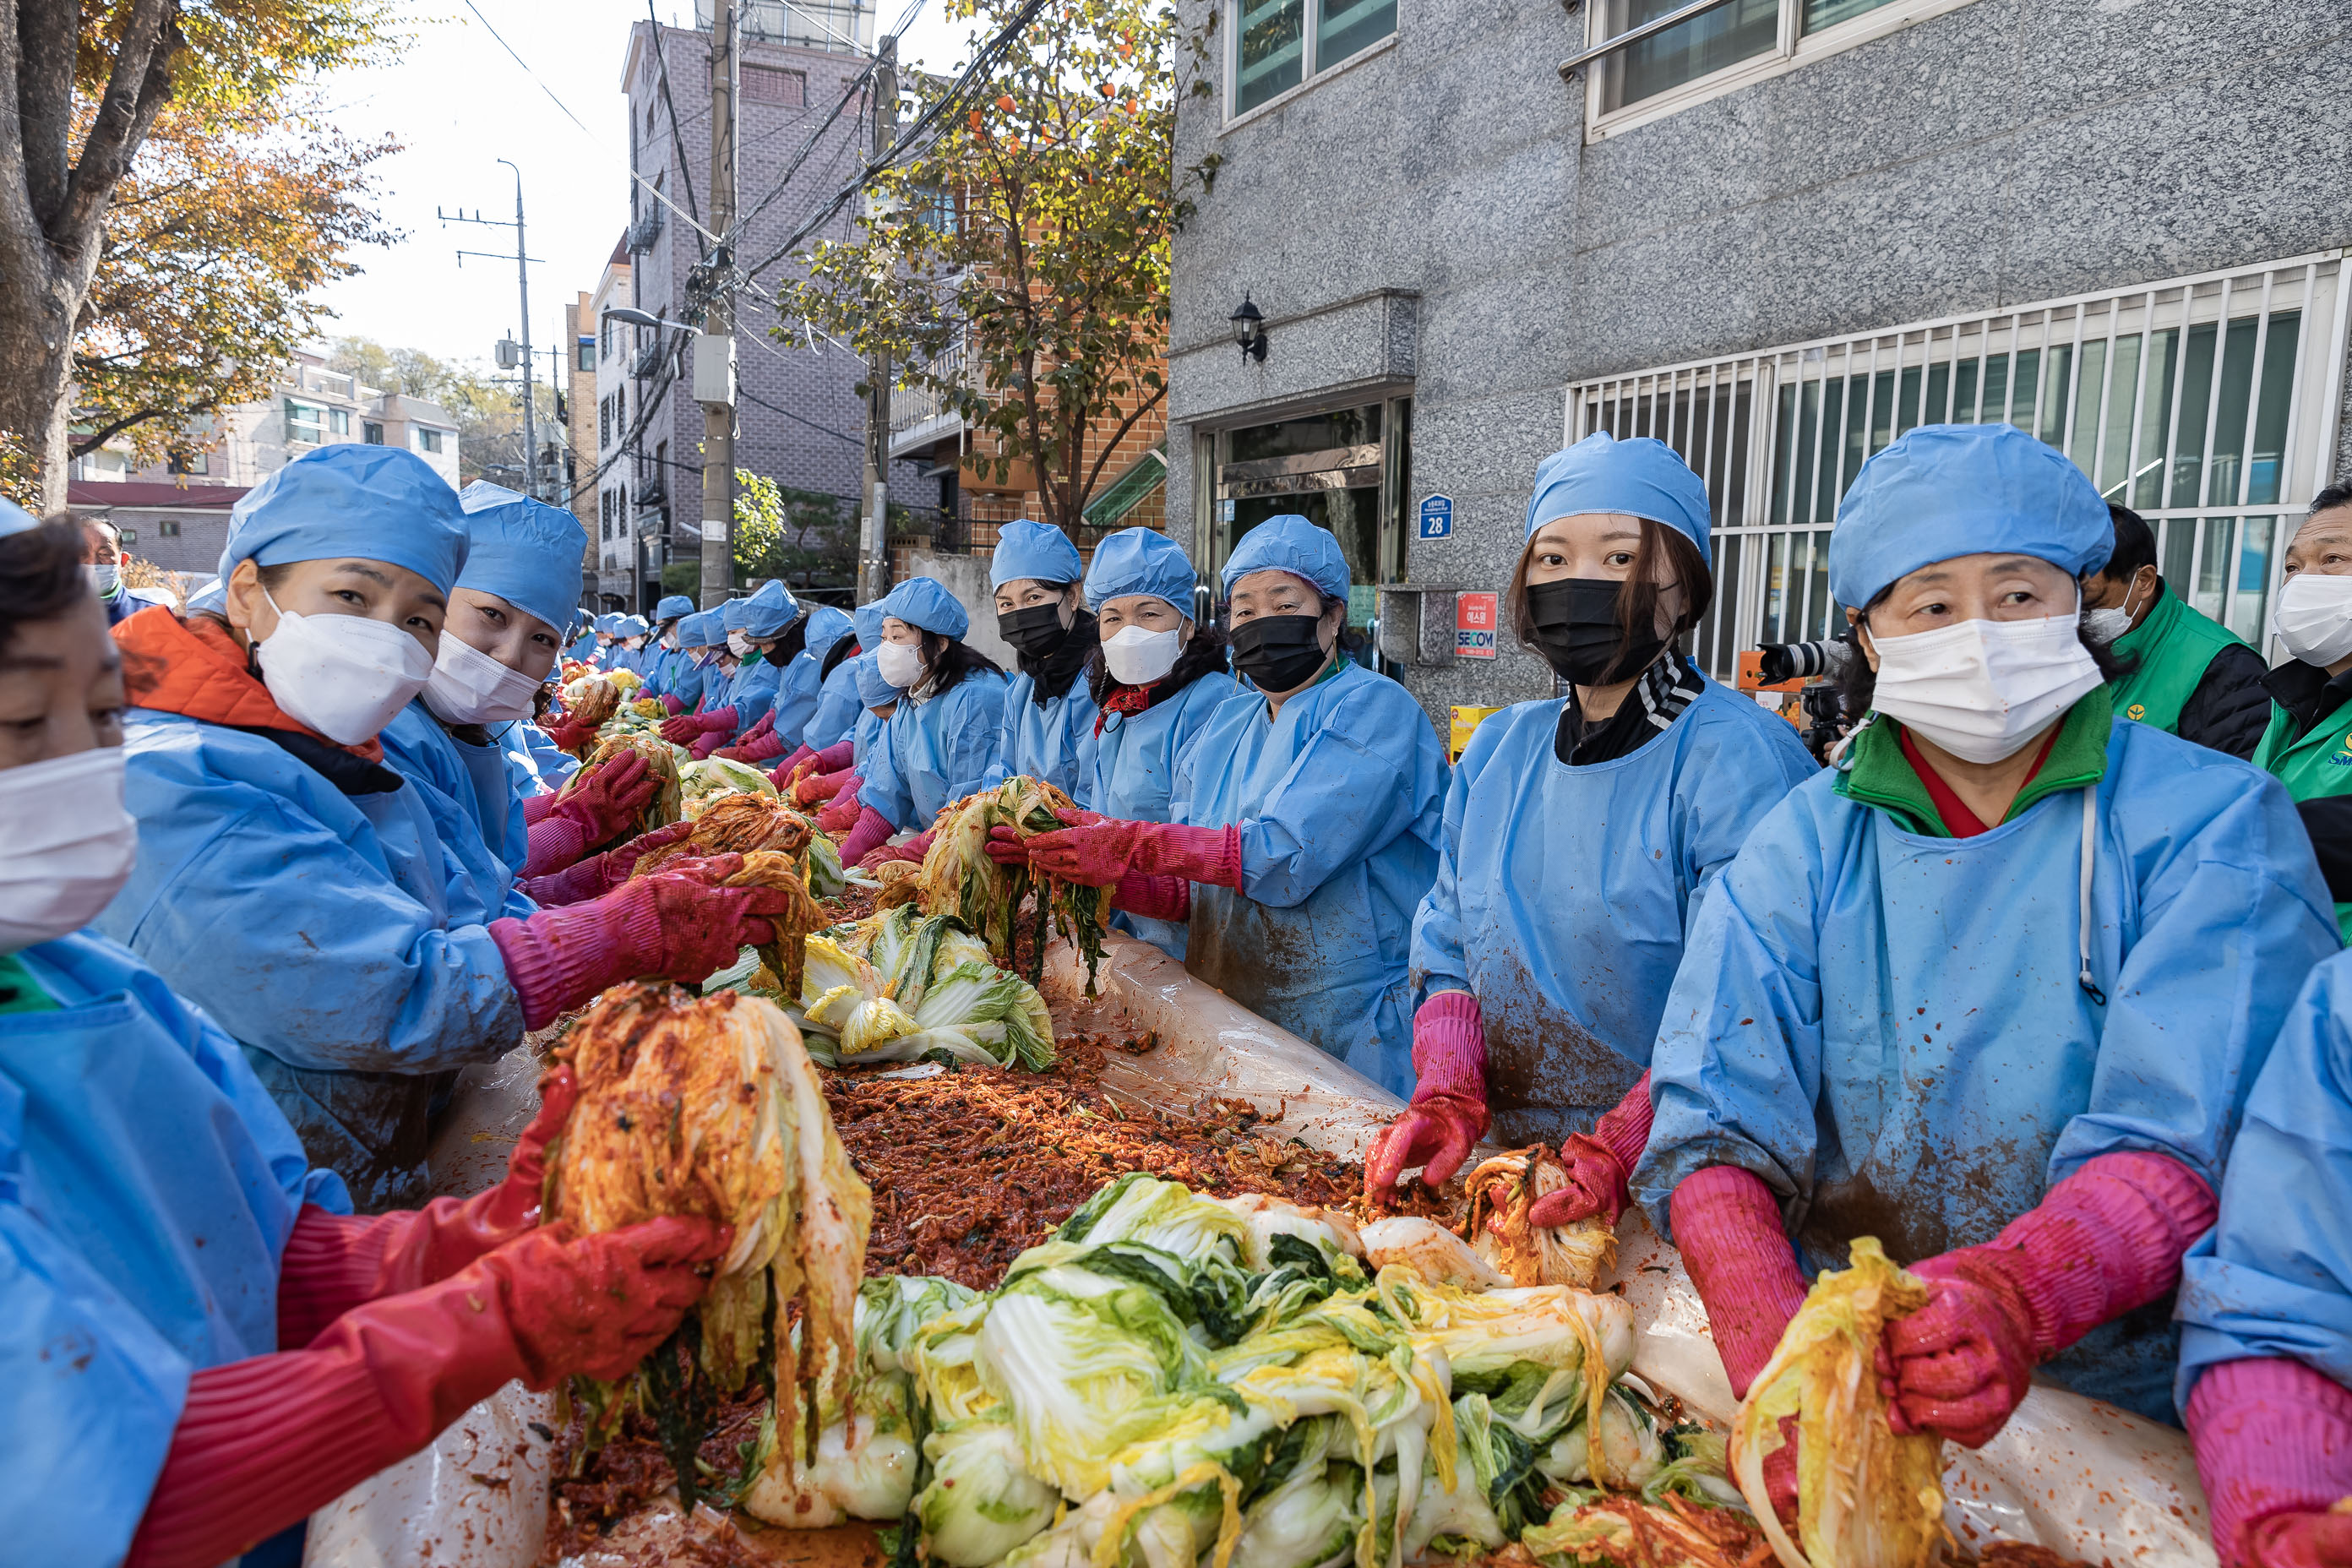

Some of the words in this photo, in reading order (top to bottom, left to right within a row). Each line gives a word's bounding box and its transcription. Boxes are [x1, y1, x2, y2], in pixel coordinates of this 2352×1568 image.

[1428, 517, 1443, 535] 28
[1467, 612, 1487, 624] 에스원
[1458, 632, 1493, 647] SECOM
